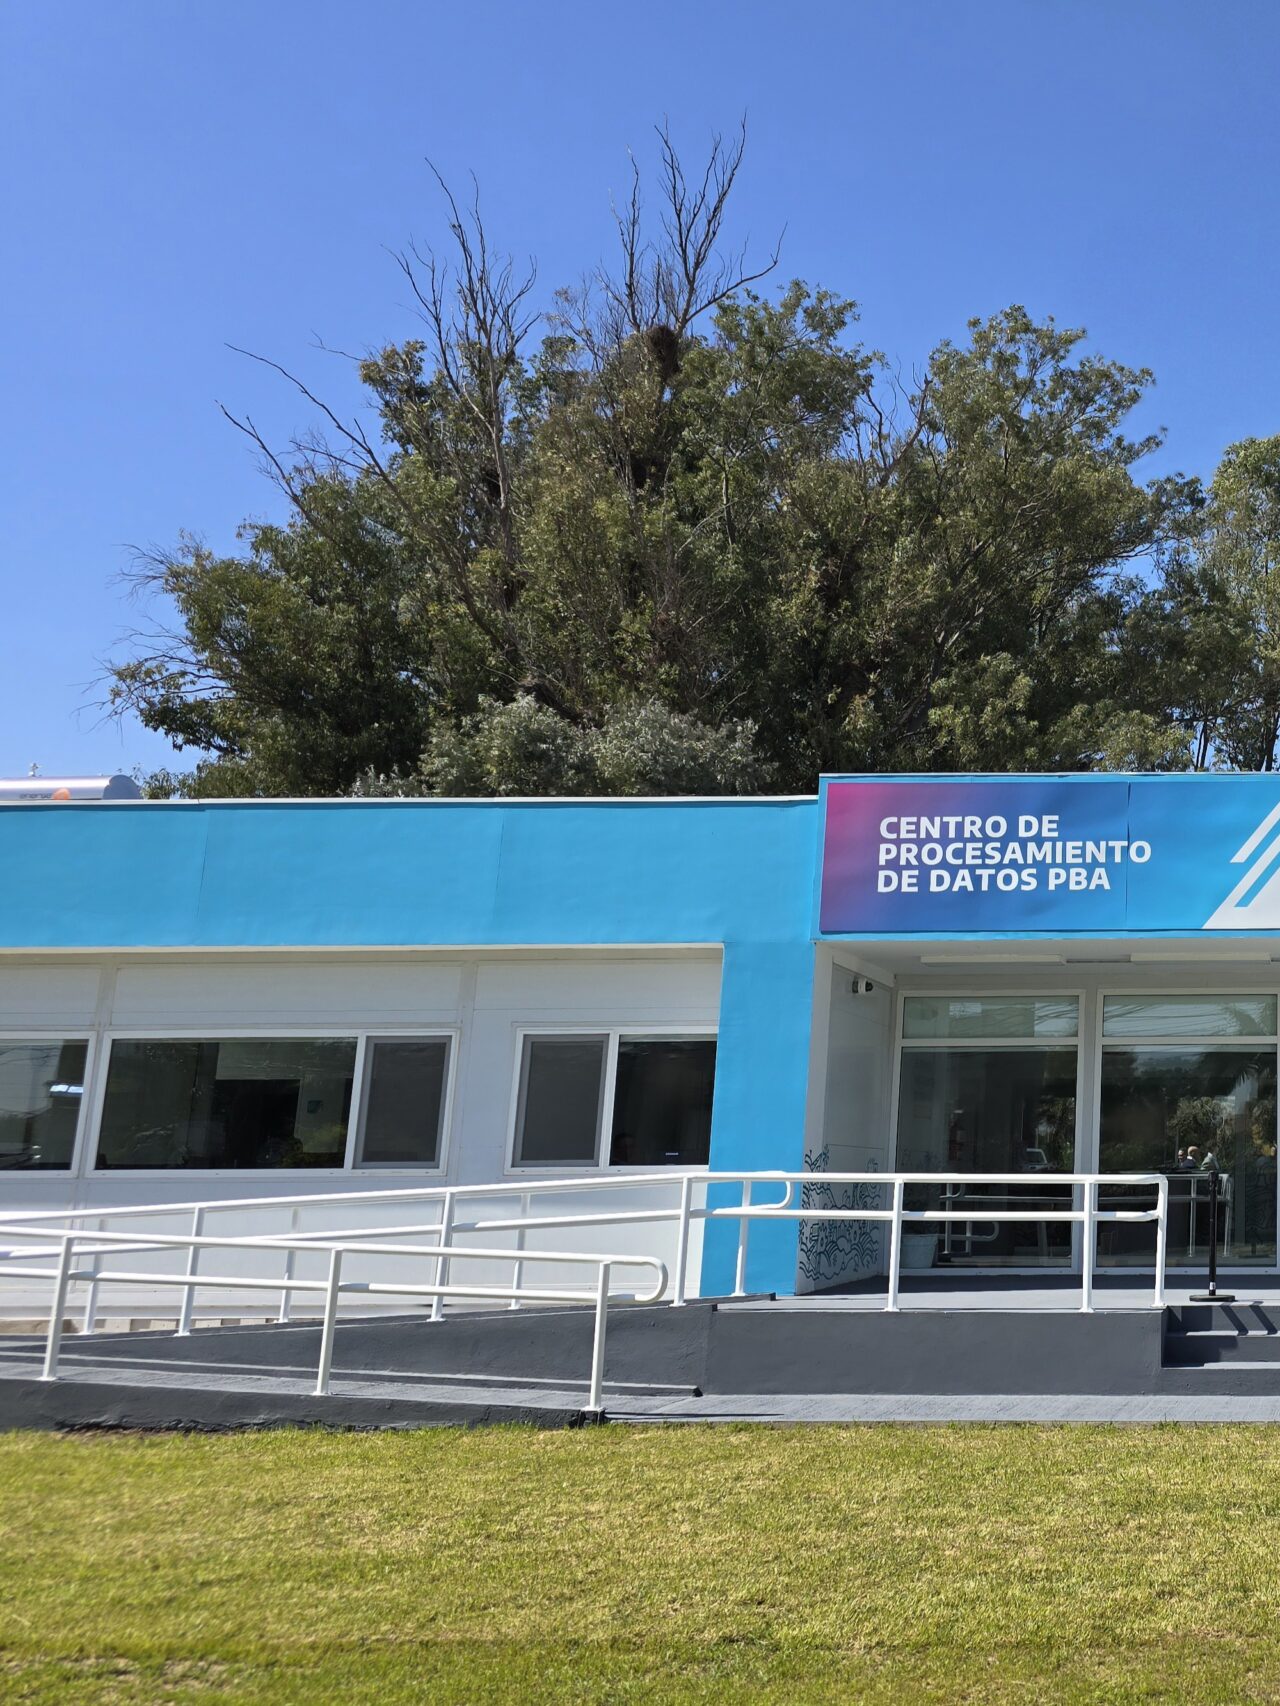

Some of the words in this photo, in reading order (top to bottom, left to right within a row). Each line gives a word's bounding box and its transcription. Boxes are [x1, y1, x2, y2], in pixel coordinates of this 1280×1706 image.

[879, 815, 1007, 839] CENTRO
[1018, 815, 1059, 838] DE
[878, 840, 1151, 865] PROCESAMIENTO
[877, 869, 919, 893] DE
[929, 868, 1038, 892] DATOS
[1048, 868, 1111, 890] PBA
